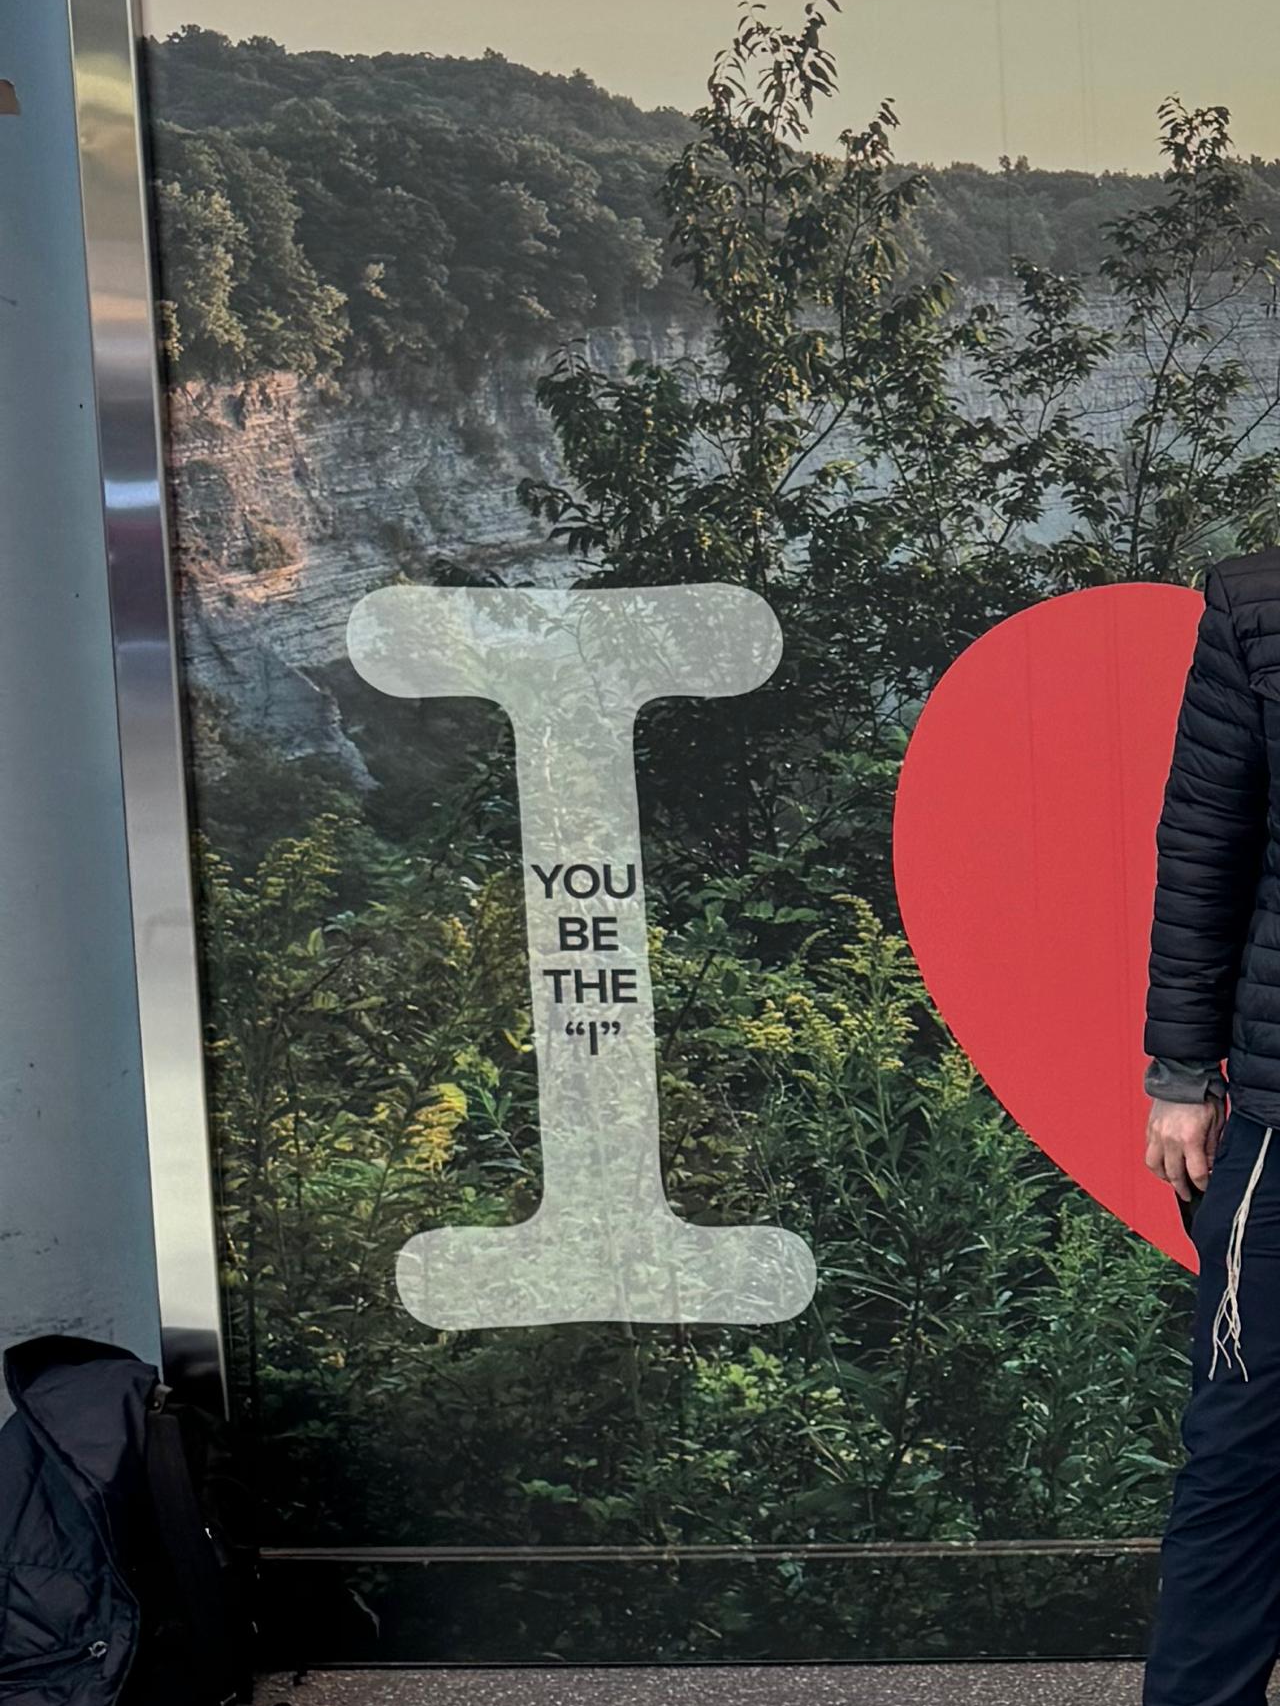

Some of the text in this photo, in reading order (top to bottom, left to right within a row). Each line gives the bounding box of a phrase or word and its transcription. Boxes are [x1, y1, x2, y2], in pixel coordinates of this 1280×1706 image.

[530, 863, 637, 900] YOU
[558, 916, 620, 952] BE
[346, 582, 816, 1331] I
[542, 969, 638, 1004] THE
